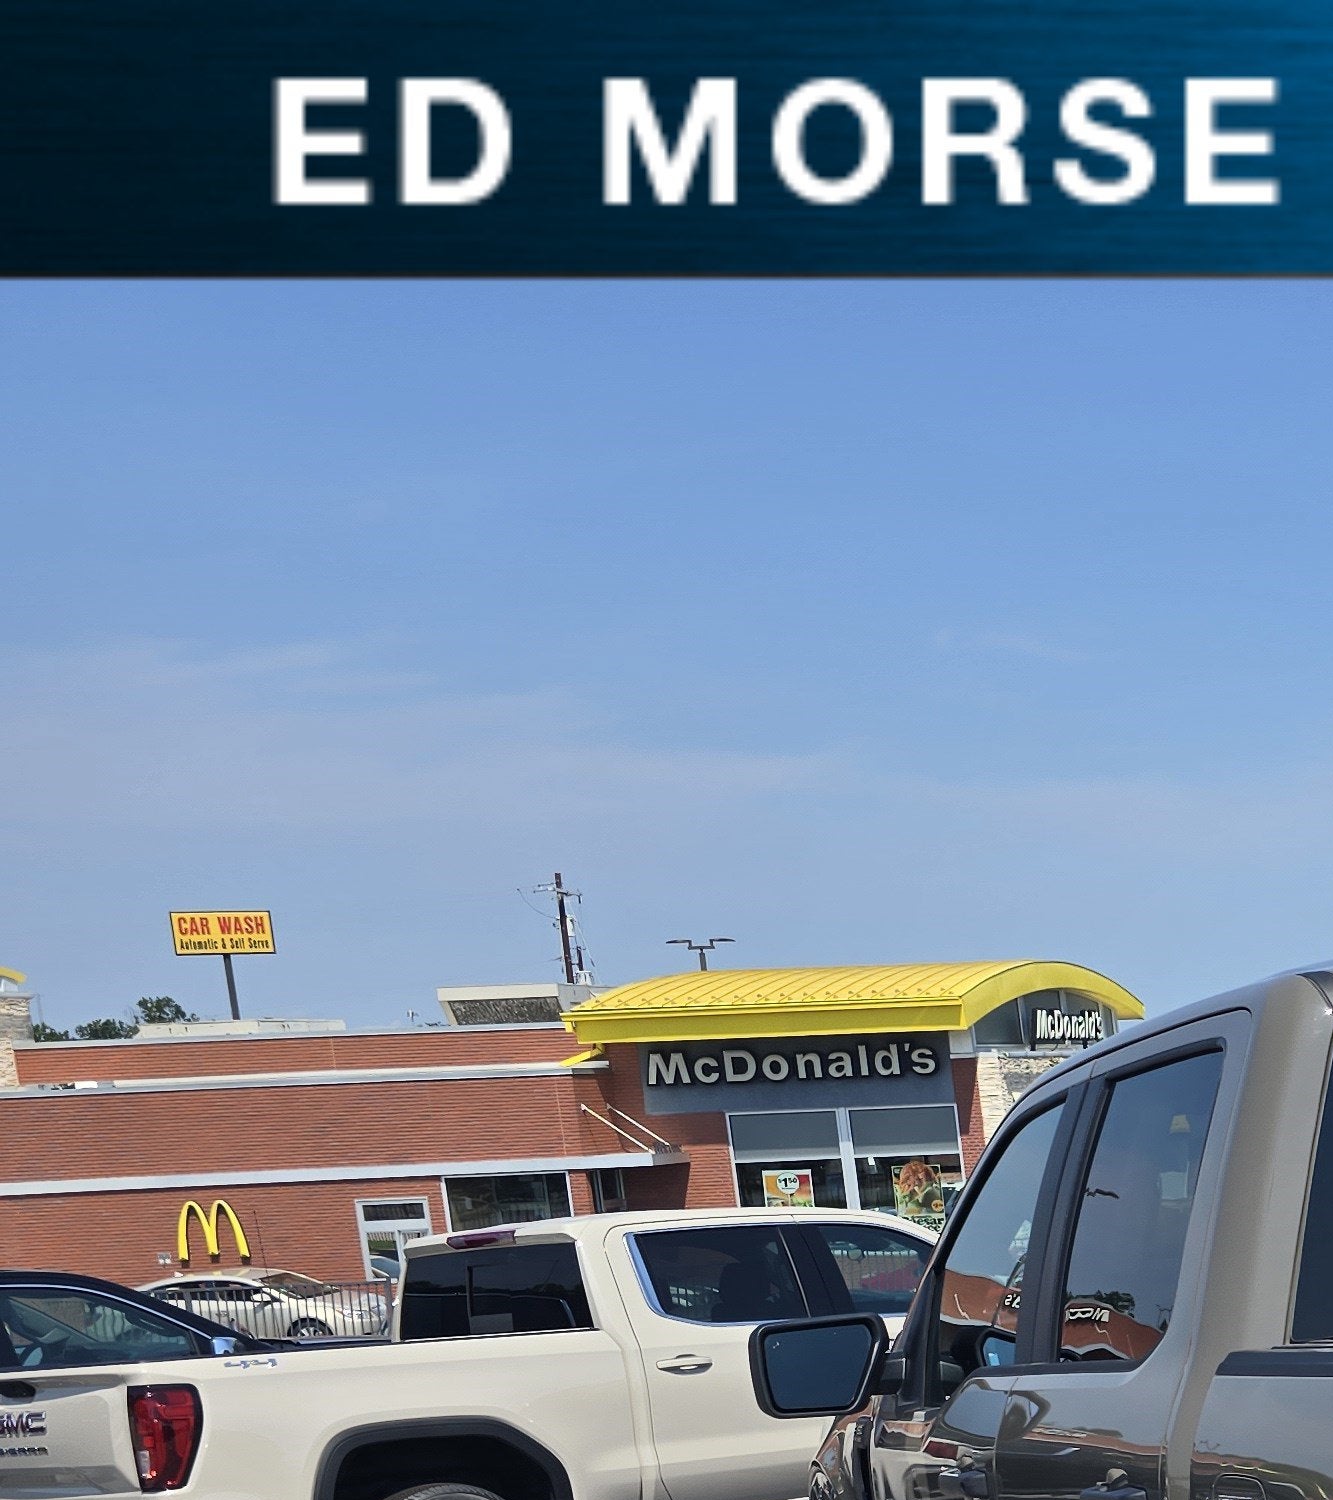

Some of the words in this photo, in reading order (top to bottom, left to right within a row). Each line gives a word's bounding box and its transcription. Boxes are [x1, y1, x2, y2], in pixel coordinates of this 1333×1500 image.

[177, 916, 211, 936] CAR
[217, 915, 266, 935] WASH
[180, 938, 219, 951] Automatic
[221, 937, 227, 950] &
[230, 937, 246, 950] Self
[248, 937, 270, 950] Serve
[1036, 1008, 1103, 1041] McDonald's
[647, 1042, 937, 1086] McDonald's
